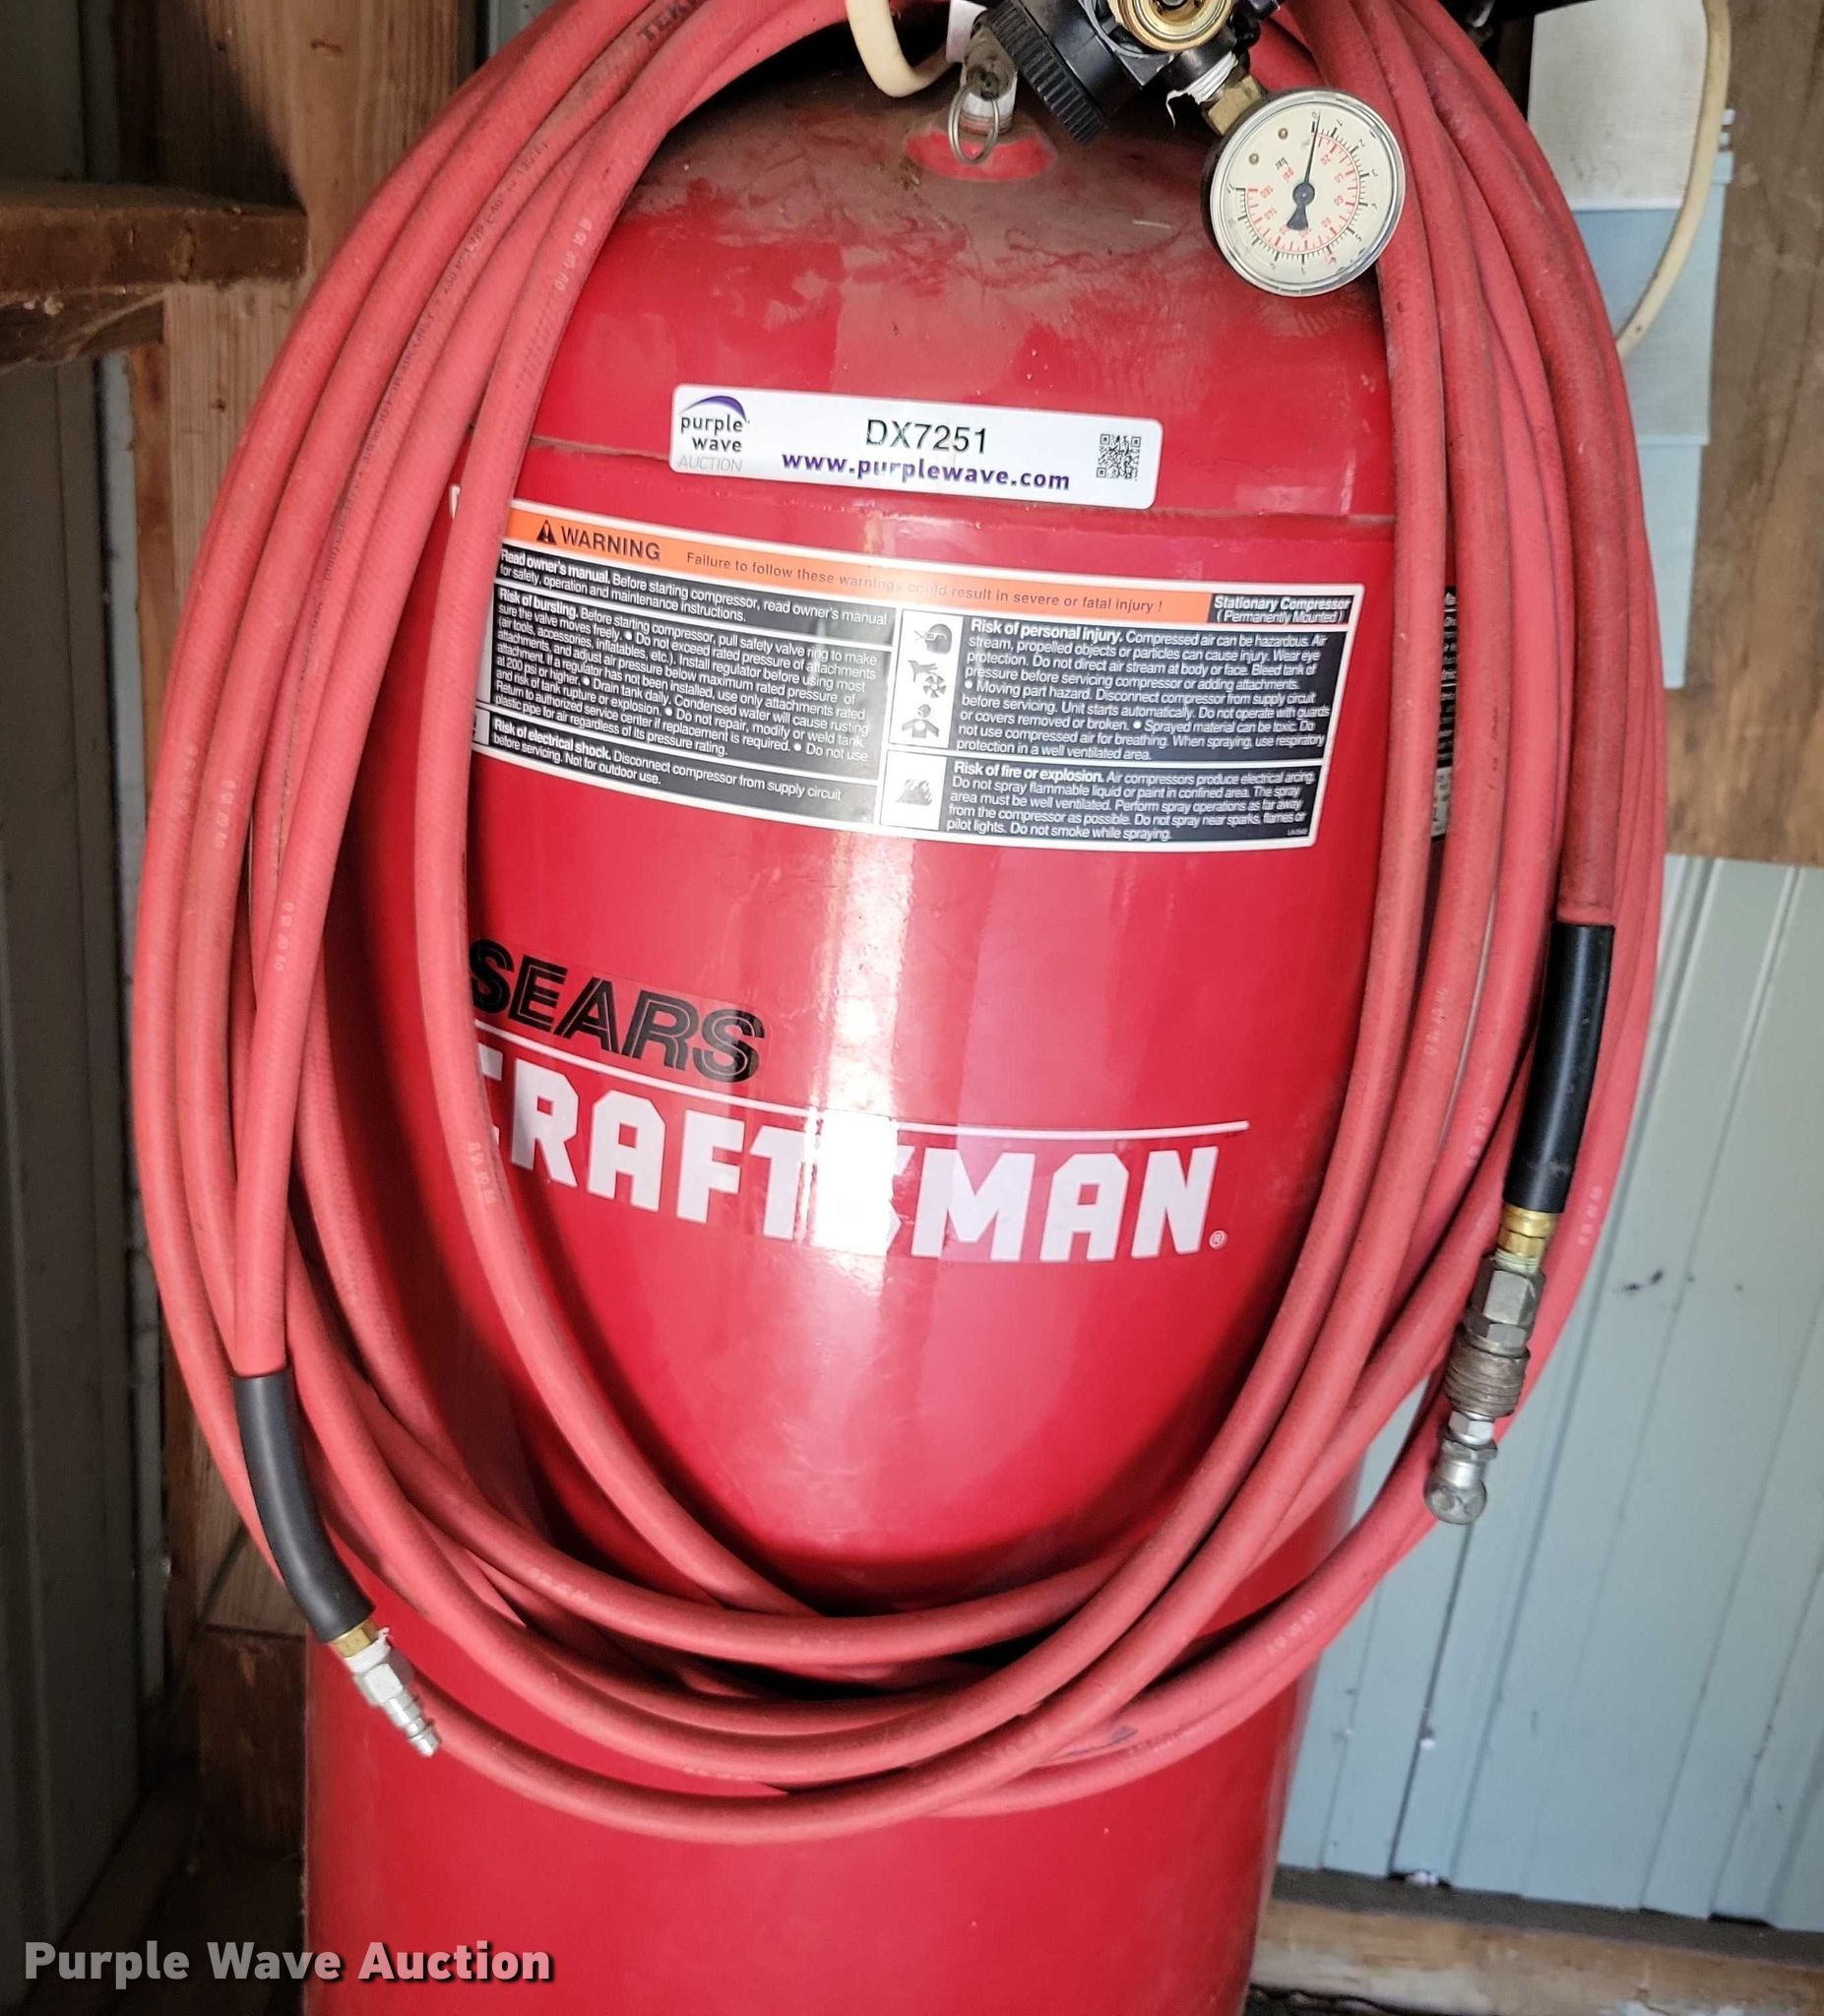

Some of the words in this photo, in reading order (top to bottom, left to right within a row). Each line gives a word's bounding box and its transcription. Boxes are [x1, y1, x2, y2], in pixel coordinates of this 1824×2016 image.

[679, 414, 743, 436] purple
[866, 417, 986, 455] DX7251
[678, 453, 742, 472] AUCTION
[692, 436, 742, 454] wave
[782, 451, 1071, 492] www.purplewave.com
[561, 526, 661, 561] WARNING
[499, 564, 512, 576] for
[543, 576, 588, 596] operation
[590, 585, 609, 598] and
[611, 589, 678, 611] maintenance
[681, 598, 746, 622] instructions.
[501, 549, 526, 565] Read
[527, 557, 566, 576] owner's
[568, 565, 610, 584] manual.
[612, 573, 647, 592] Before
[649, 581, 689, 599] starting
[691, 590, 760, 611] compressor,
[763, 599, 790, 613] read
[791, 604, 839, 620] owner's
[842, 610, 887, 625] manual
[687, 551, 730, 570] Failure
[735, 562, 748, 573] to
[752, 563, 792, 579] follow
[797, 568, 835, 583] these
[839, 573, 903, 593] warnings
[951, 587, 992, 600] result
[996, 590, 1008, 601] in
[1014, 593, 1059, 606] severe
[1064, 597, 1079, 607] or
[1083, 597, 1111, 610] fatal
[1115, 599, 1154, 614] injury
[1214, 595, 1279, 612] Stationary
[1280, 597, 1351, 611] Compressor
[499, 589, 521, 604] Risk
[522, 594, 533, 606] of
[534, 598, 579, 620] bursting.
[581, 607, 612, 625] Before
[613, 615, 650, 634] starting
[652, 621, 716, 645] compressor,
[719, 634, 738, 648] pull
[739, 637, 773, 654] safety
[775, 643, 805, 657] valve
[807, 647, 828, 662] ring
[831, 650, 842, 662] to
[845, 652, 878, 666] make
[499, 604, 518, 617] sure
[519, 605, 533, 620] the
[535, 611, 557, 627] valve
[560, 617, 591, 634] moves
[593, 621, 622, 641] freely.
[636, 632, 652, 646] Do
[653, 635, 669, 650] not
[671, 639, 710, 657] exceed
[712, 647, 739, 662] rated
[741, 653, 790, 670] pressure
[793, 658, 805, 670] of
[805, 662, 877, 680] attachments
[971, 618, 1002, 634] Risk
[1004, 621, 1020, 635] of
[1021, 622, 1080, 640] personal
[1082, 627, 1123, 646] injury.
[1125, 630, 1201, 649] Compressed
[1200, 633, 1216, 646] air
[1217, 636, 1238, 647] can
[1239, 633, 1252, 647] be
[1311, 634, 1329, 647] Air
[968, 636, 1014, 653] stream,
[1017, 641, 1073, 656] propelled
[1074, 643, 1116, 659] objects
[1118, 647, 1132, 658] or
[1132, 645, 1180, 661] particles
[1181, 649, 1203, 661] can
[1205, 651, 1238, 662] cause
[1272, 649, 1300, 662] Wear
[1300, 651, 1321, 663] eye
[965, 666, 1019, 680] pressure
[1020, 668, 1059, 683] before
[1060, 672, 1112, 689] servicing
[1114, 676, 1181, 689] compressor
[1183, 679, 1196, 690] or
[1198, 678, 1234, 693] adding
[975, 680, 1021, 698] Moving
[1022, 685, 1046, 699] part
[1048, 685, 1093, 701] hazard.
[1096, 688, 1159, 704] Disconnect
[1161, 693, 1226, 707] compressor
[1226, 692, 1251, 705] from
[1252, 694, 1286, 708] supply
[493, 732, 521, 750] before
[522, 742, 563, 765] servicing.
[565, 752, 583, 768] Not
[584, 755, 598, 770] for
[598, 761, 638, 780] outdoor
[640, 772, 661, 786] use.
[494, 718, 516, 734] Risk
[517, 724, 528, 737] of
[528, 728, 573, 751] electrical
[575, 739, 611, 760] shock.
[613, 749, 670, 775] Disconnect
[672, 762, 737, 786] compressor
[739, 774, 766, 789] from
[767, 781, 805, 799] supply
[807, 787, 842, 801] circuit
[953, 760, 983, 776] Risk
[985, 762, 1001, 777] of
[1001, 763, 1022, 779] fire
[1024, 768, 1038, 780] or
[1039, 769, 1104, 786] explosion.
[1106, 771, 1121, 783] Air
[1124, 774, 1194, 787] compressors
[1196, 773, 1239, 788] produce
[946, 818, 972, 832] pilot
[974, 820, 1008, 835] lights.
[1010, 822, 1028, 836] Do
[1030, 824, 1049, 837] not
[1051, 825, 1091, 838] smoke
[1092, 825, 1122, 839] while
[1123, 827, 1172, 842] spraying.
[469, 938, 766, 1084] SEARS
[477, 1042, 1219, 1262] RAFTMAN
